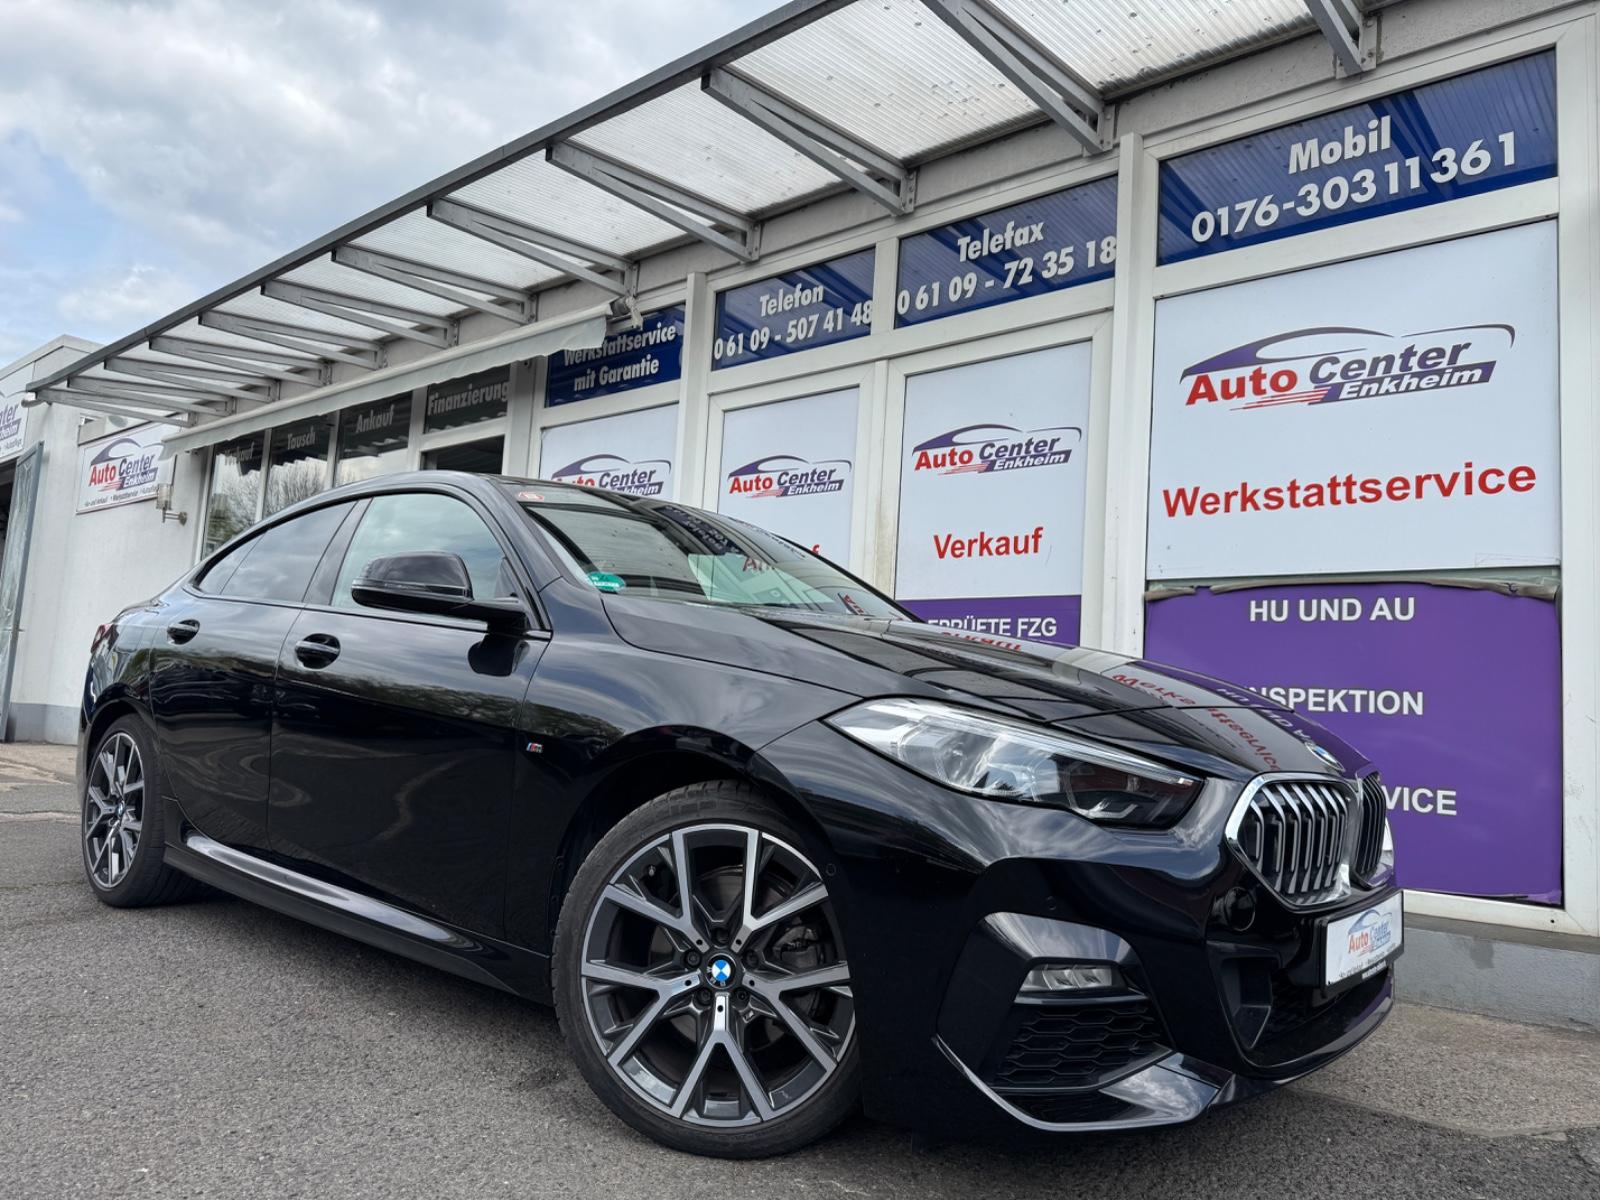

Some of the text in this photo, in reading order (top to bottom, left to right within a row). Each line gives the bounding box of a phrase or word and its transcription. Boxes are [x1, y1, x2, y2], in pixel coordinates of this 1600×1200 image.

[1289, 115, 1391, 174] Mobil
[957, 220, 1044, 263] Telefax
[897, 289, 910, 315] 0
[915, 282, 940, 311] 61
[948, 272, 977, 302] 09
[1003, 257, 1034, 289] 72
[1042, 246, 1074, 279] 35
[1086, 235, 1117, 268] 18
[760, 283, 824, 317] Telefon
[713, 338, 724, 360] 0
[726, 333, 744, 357] 61
[750, 327, 770, 352] 09
[786, 314, 819, 344] 507
[823, 307, 843, 333] 41
[851, 299, 873, 327] 48
[574, 354, 659, 392] mit Garantie
[1185, 342, 1471, 406] Auto Center
[1339, 366, 1483, 400] Enkheim
[428, 381, 510, 416] Finanzierung
[356, 404, 395, 433] Ankauf
[287, 425, 316, 450] Tausch
[914, 437, 1060, 471] Auto Center
[89, 454, 155, 487] Auto Center
[599, 468, 656, 489] Center
[993, 452, 1066, 471] Enkheim
[729, 468, 836, 494] Auto Center
[788, 482, 839, 496] Enkheim
[1162, 462, 1536, 517] Werkstattservice
[933, 526, 1044, 560] Verkauf
[1249, 597, 1415, 622] HU UND AU
[1017, 617, 1057, 638] FZG
[1381, 785, 1457, 816] VICE
[1348, 931, 1369, 954] Auto
